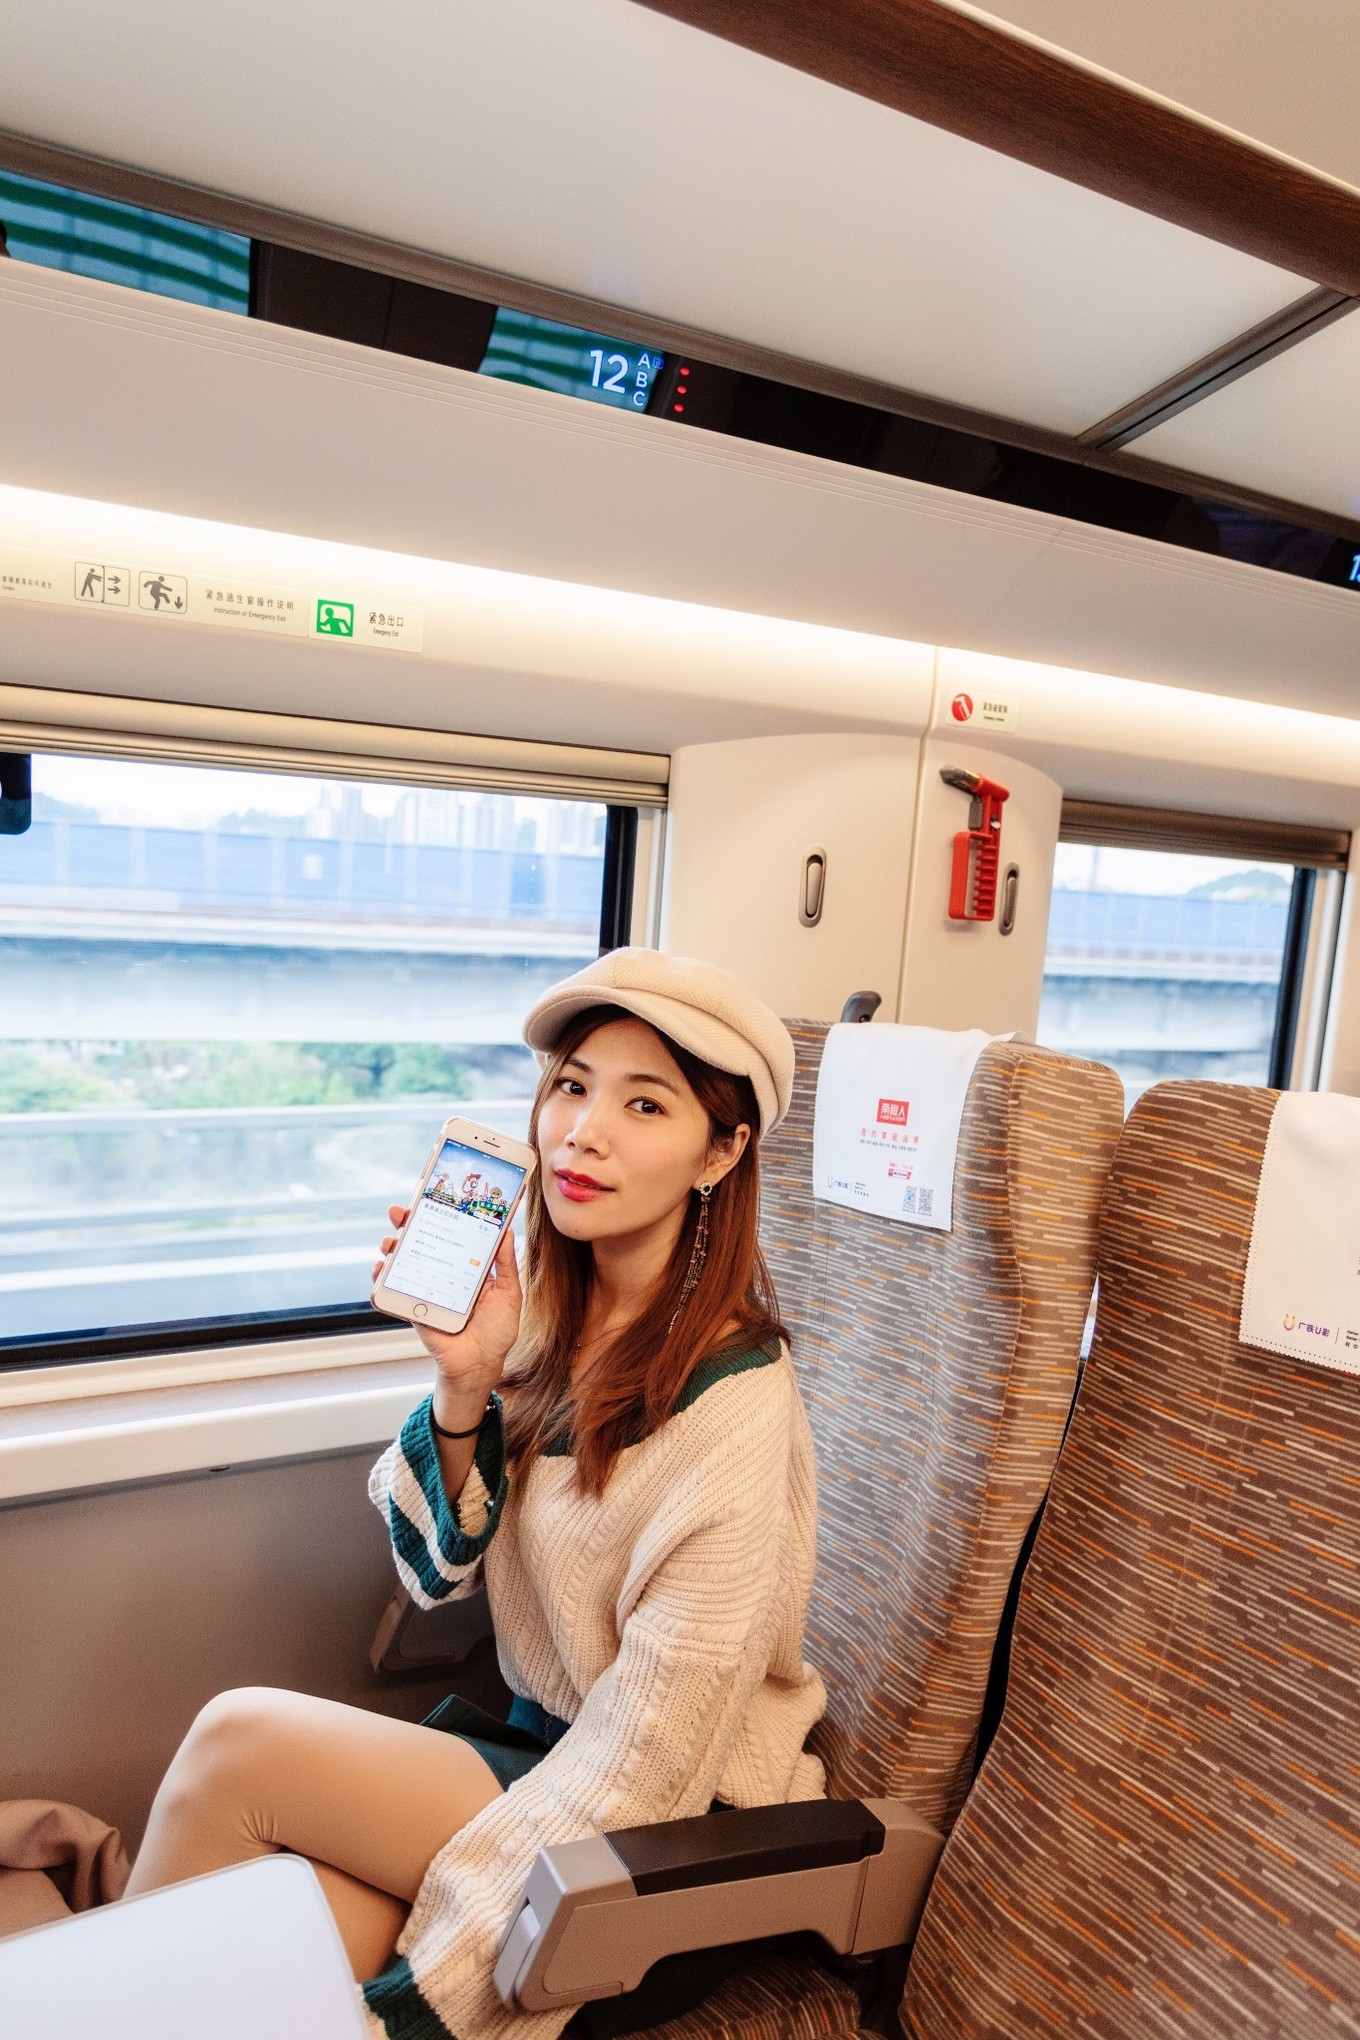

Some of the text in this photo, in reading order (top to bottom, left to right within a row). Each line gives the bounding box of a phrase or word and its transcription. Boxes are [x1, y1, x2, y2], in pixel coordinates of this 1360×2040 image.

[637, 353, 651, 369] A
[590, 349, 629, 394] 12
[635, 371, 648, 388] B
[633, 391, 646, 407] C
[1349, 554, 1360, 583] 1
[368, 611, 404, 627] 紧急出口
